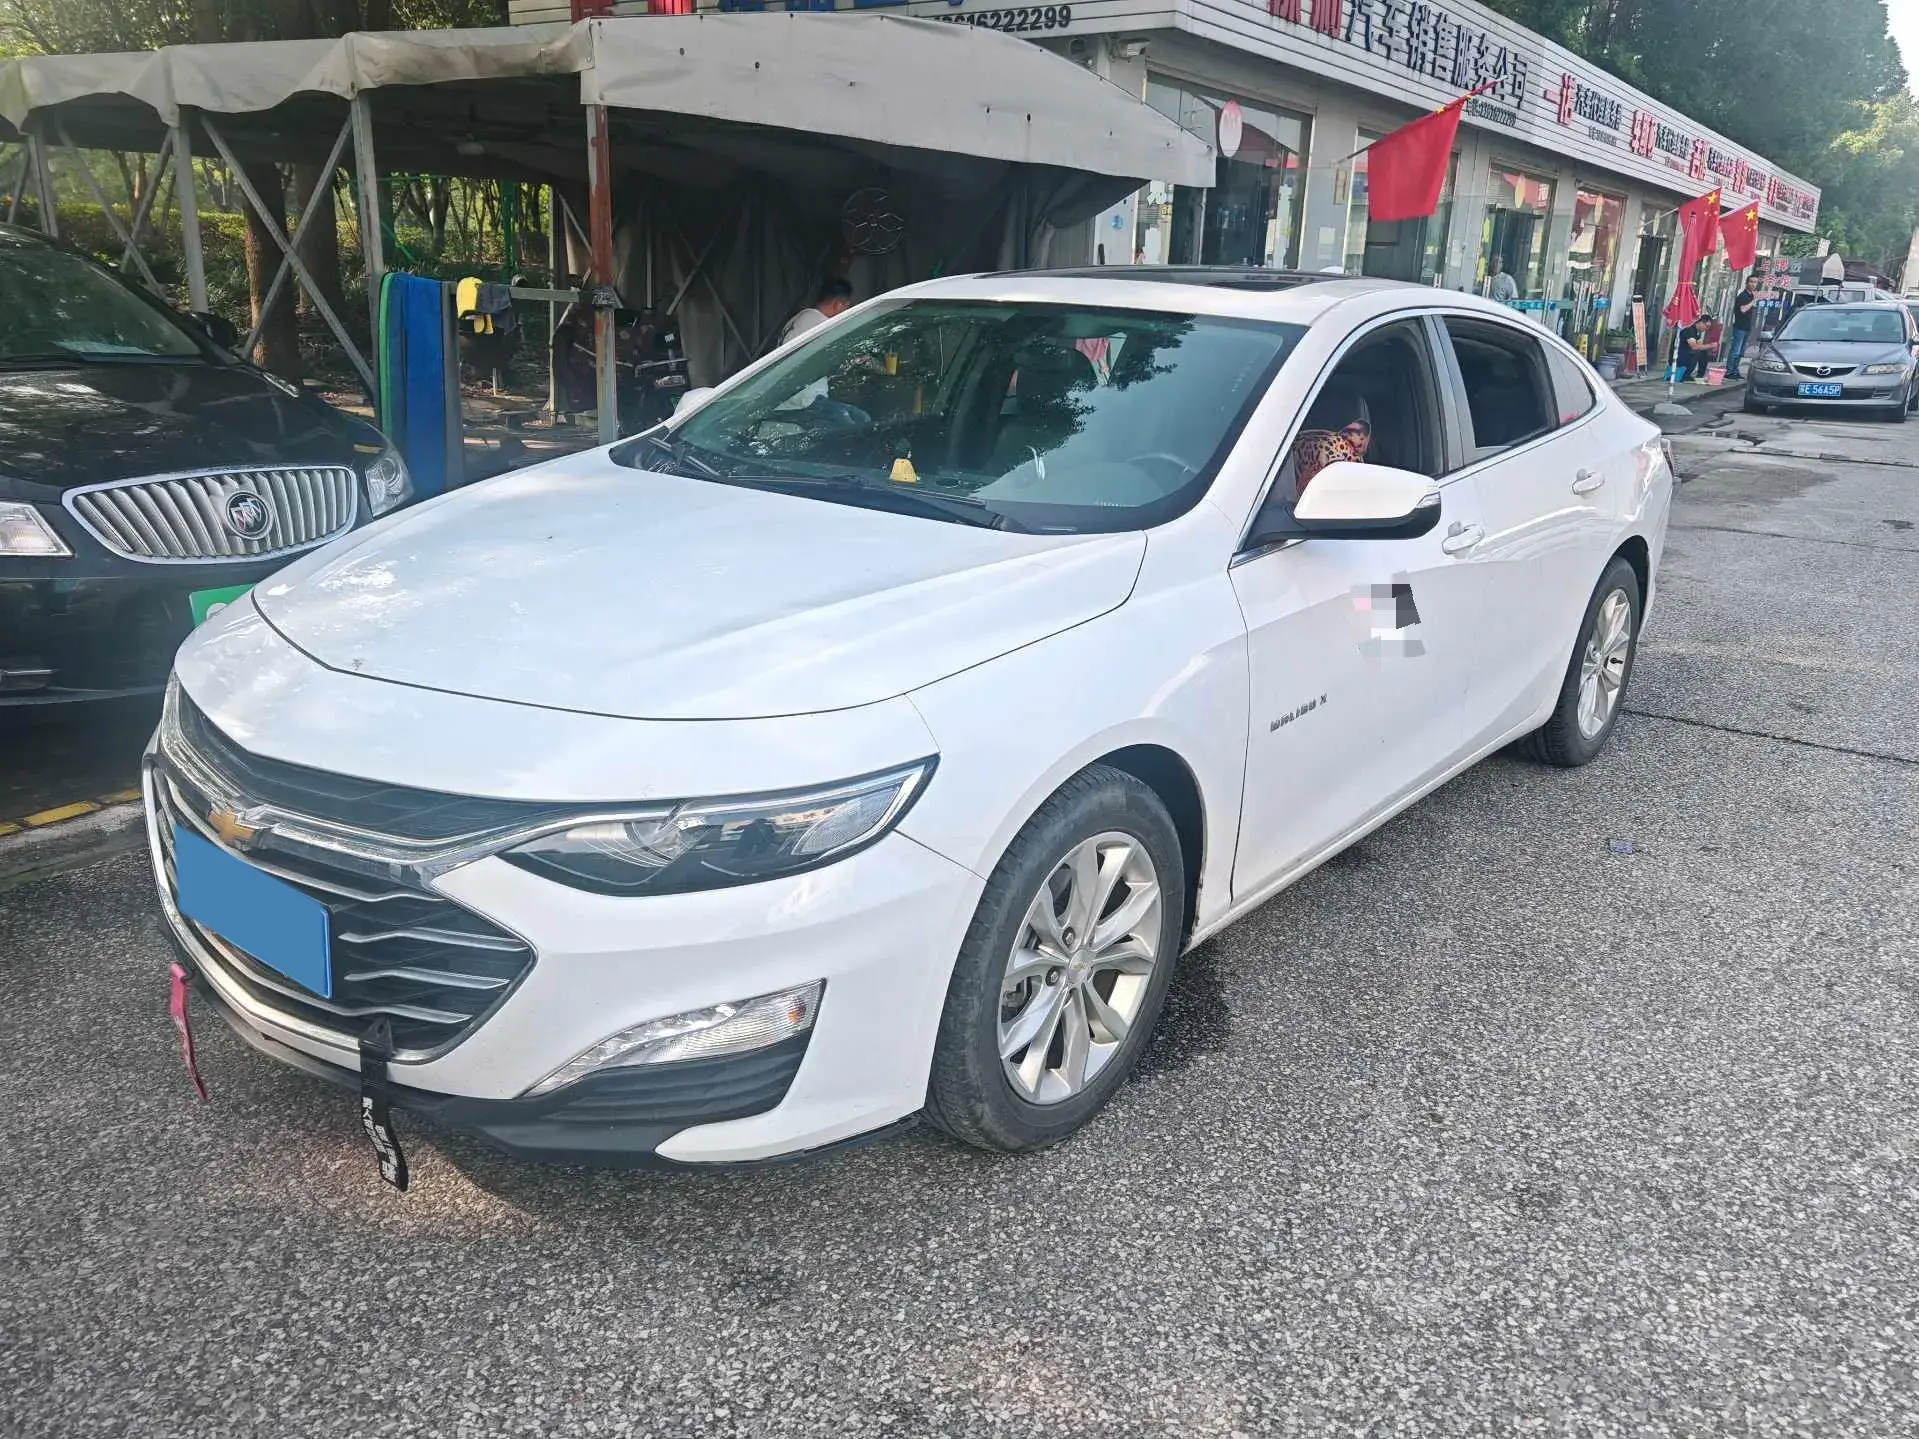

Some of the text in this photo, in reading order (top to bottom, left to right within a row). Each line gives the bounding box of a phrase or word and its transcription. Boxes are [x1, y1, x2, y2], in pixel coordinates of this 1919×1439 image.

[1267, 0, 1528, 110] 汽车销售服务公司
